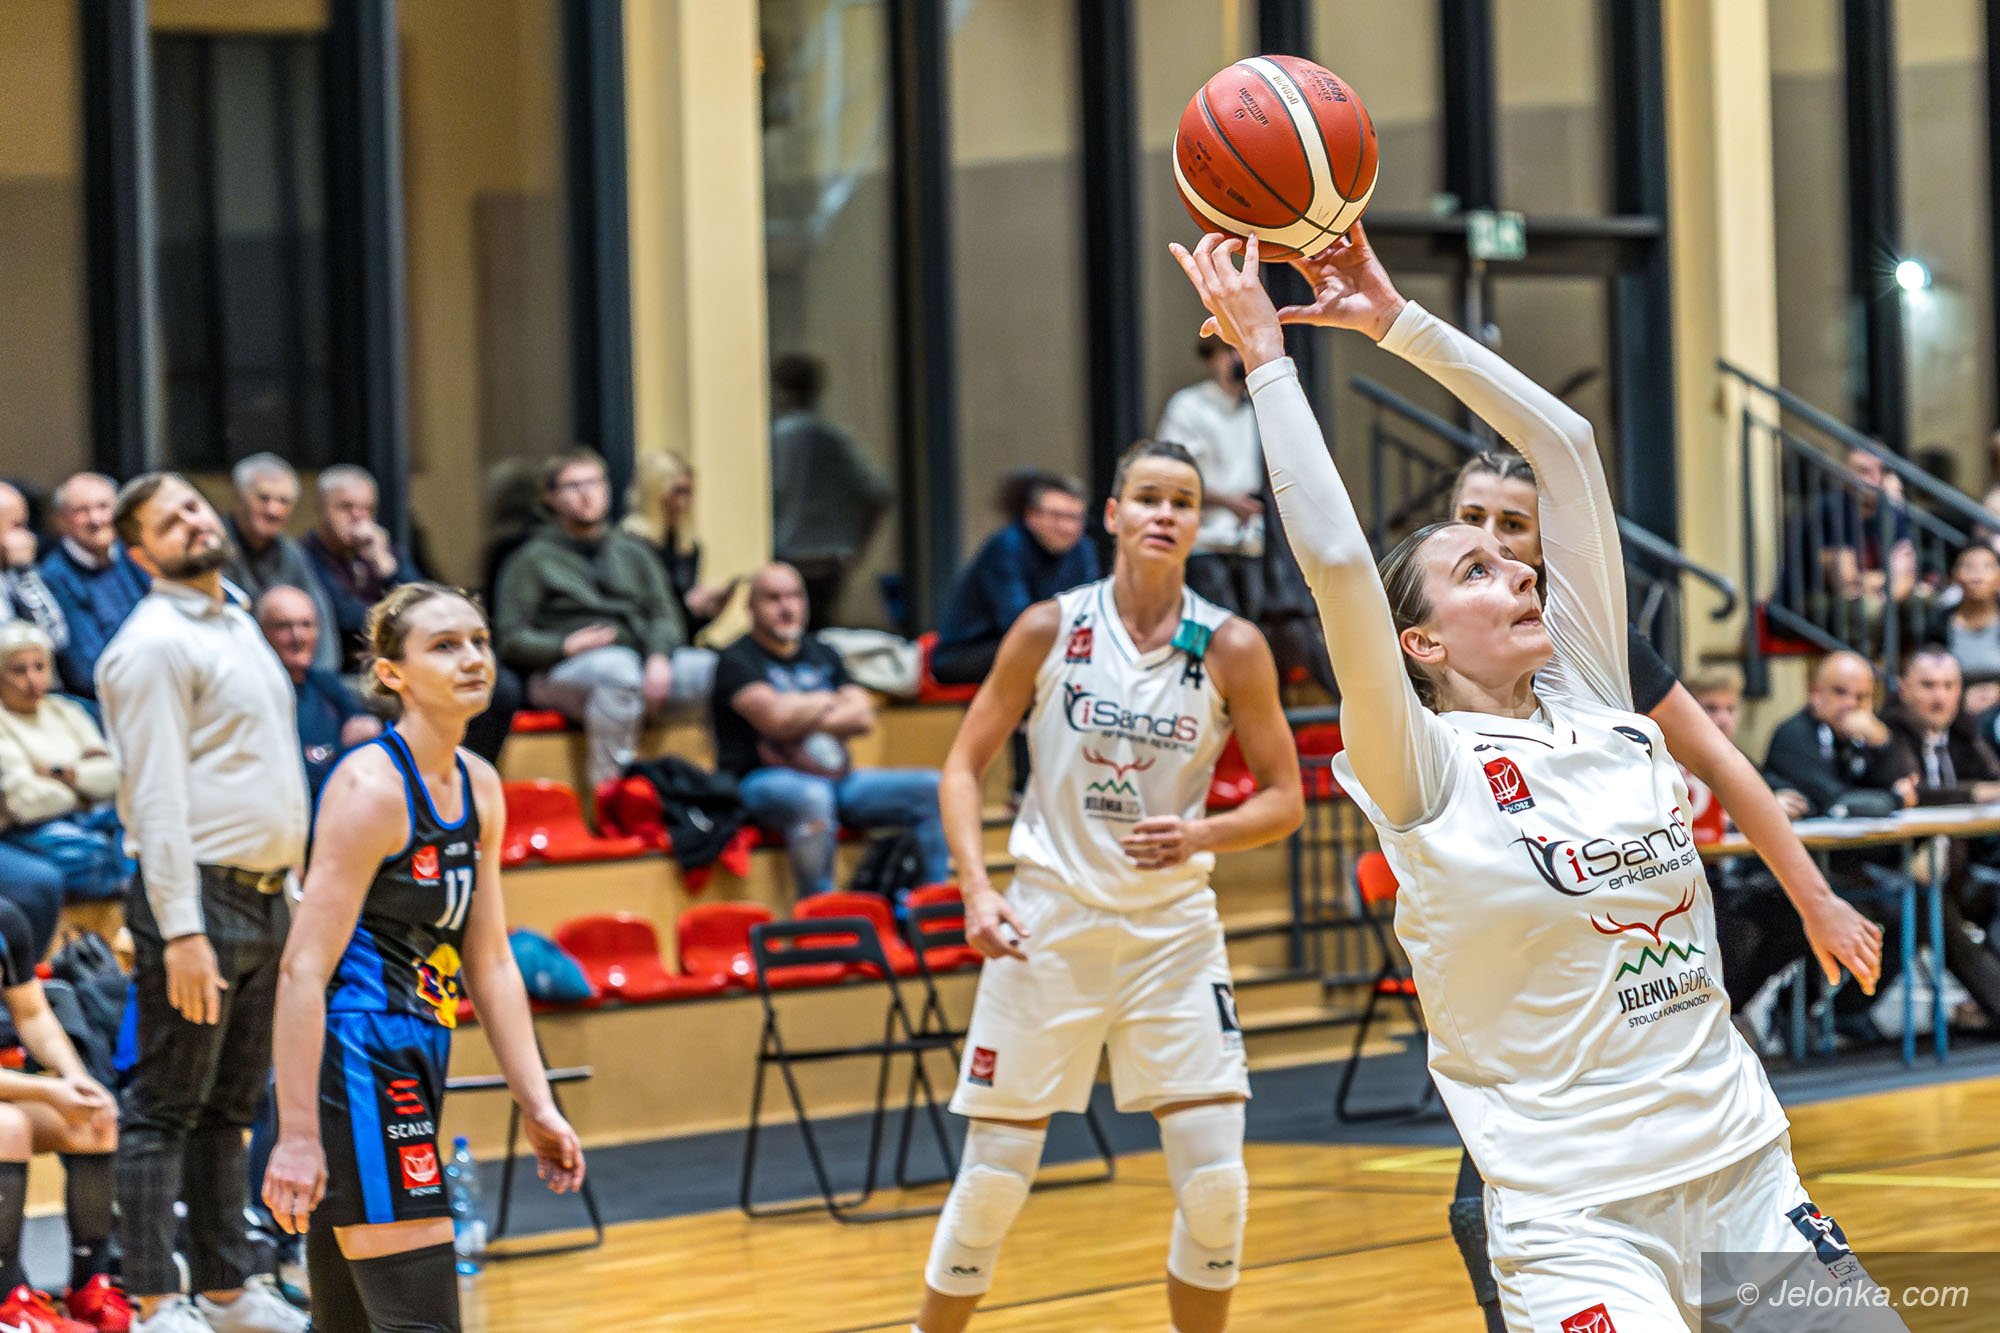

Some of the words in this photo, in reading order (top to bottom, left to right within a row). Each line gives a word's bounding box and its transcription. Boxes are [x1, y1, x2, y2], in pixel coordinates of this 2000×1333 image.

[1081, 700, 1198, 742] iSandS
[1608, 858, 1680, 890] enklawa
[435, 868, 474, 931] 17
[1618, 976, 1679, 1014] JELENIA
[1628, 1010, 1663, 1028] STOLICA
[1662, 993, 1712, 1016] KARKONOSZY
